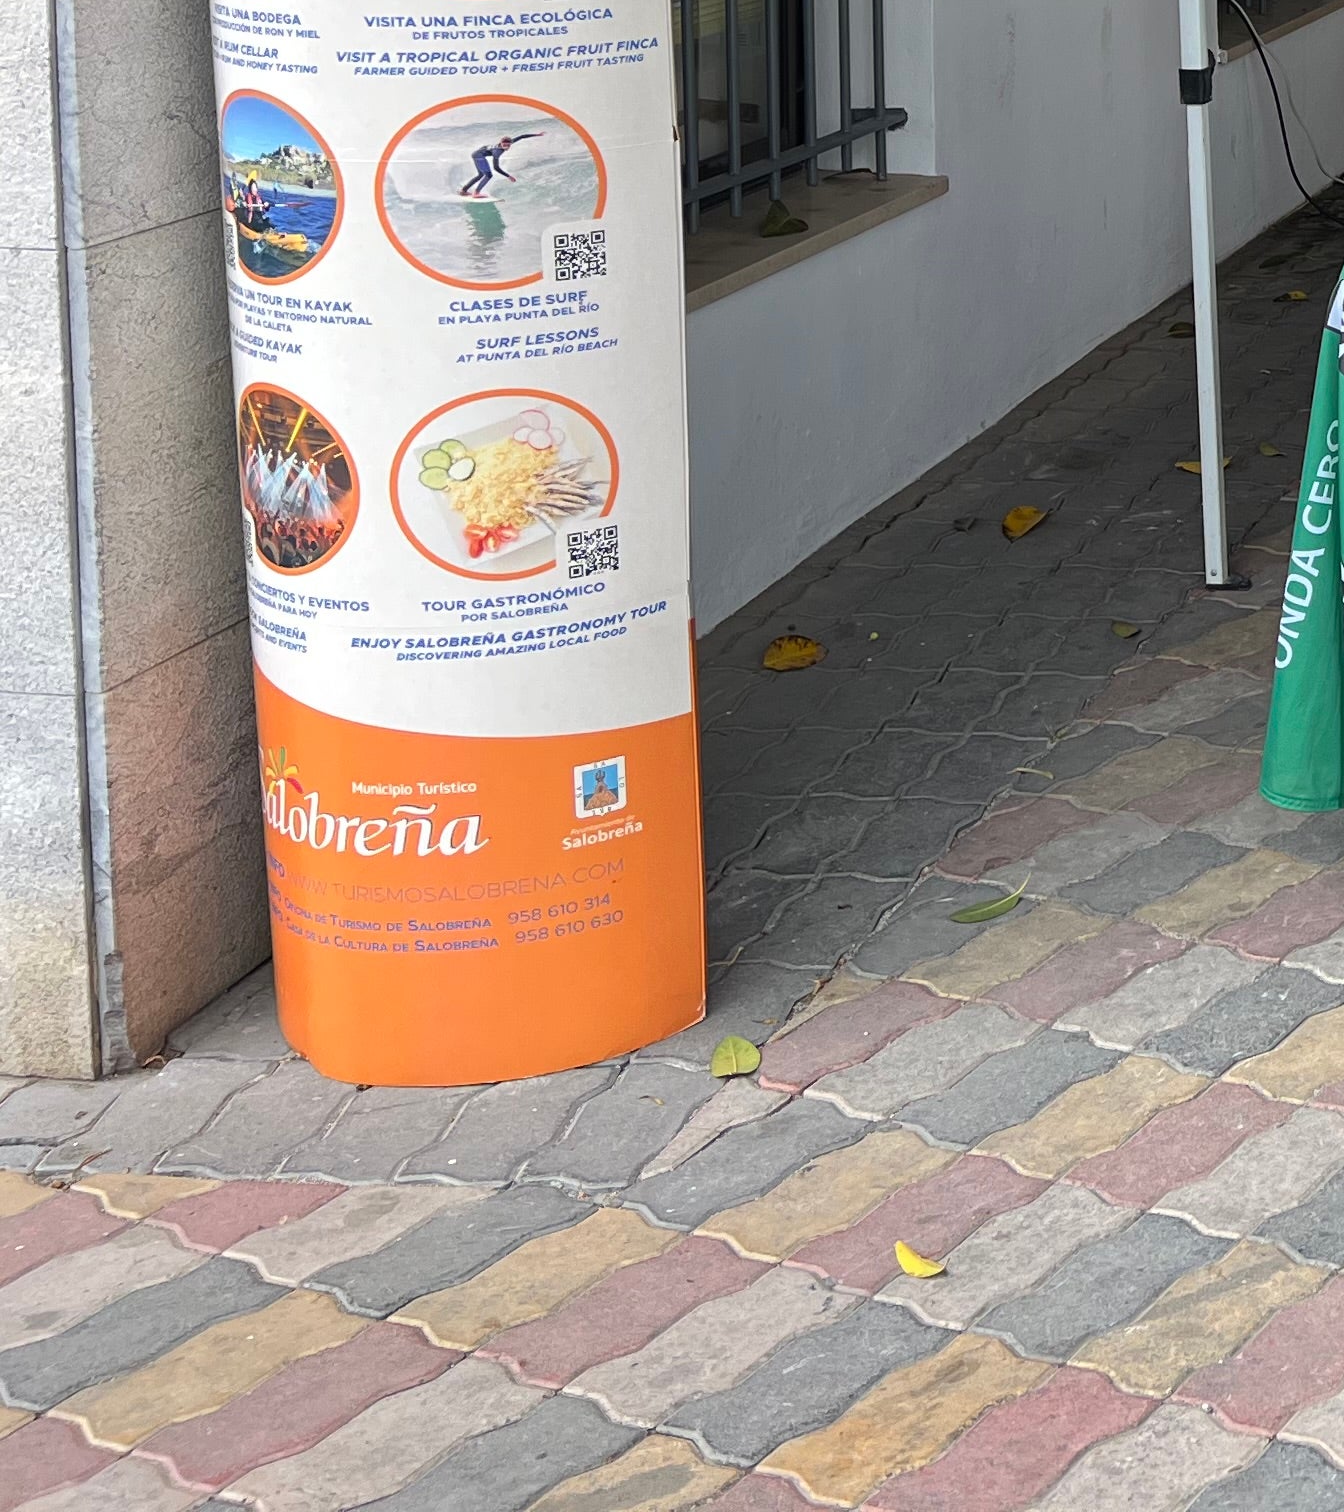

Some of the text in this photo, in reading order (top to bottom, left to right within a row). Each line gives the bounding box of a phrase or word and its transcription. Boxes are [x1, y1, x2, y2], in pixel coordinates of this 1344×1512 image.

[252, 11, 301, 25] BODEGA
[364, 8, 613, 28] VISITA UNA FINCA ECOLÓGICA
[412, 26, 568, 40] DE FRUTOS TROPICALES
[241, 44, 278, 59] CELLAR
[336, 38, 659, 63] VISIT A TROPICAL ORGANIC FRUIT FINCA
[354, 59, 592, 76] FARMER GUIDED TOUR FRESH FRUIT
[304, 300, 352, 312] KAYAK
[450, 291, 588, 312] CLASES DE SURF
[274, 310, 317, 323] ENTORNO
[438, 306, 575, 325] EN PLAYA PUNTA DEL
[476, 327, 599, 350] SURF LESSONS
[577, 338, 618, 352] BEACH
[1274, 420, 1339, 668] ONDA CERO
[308, 596, 369, 611] EVENTOS
[421, 582, 606, 613] TOUR GASTRONÓMICO
[351, 600, 667, 649] ENJOY SALOBREÑA GASTRONOMY TOUR
[352, 781, 477, 797] Municipio Turístico
[562, 821, 643, 850] Salobreña
[584, 893, 610, 910] 314
[591, 910, 624, 928] 630
